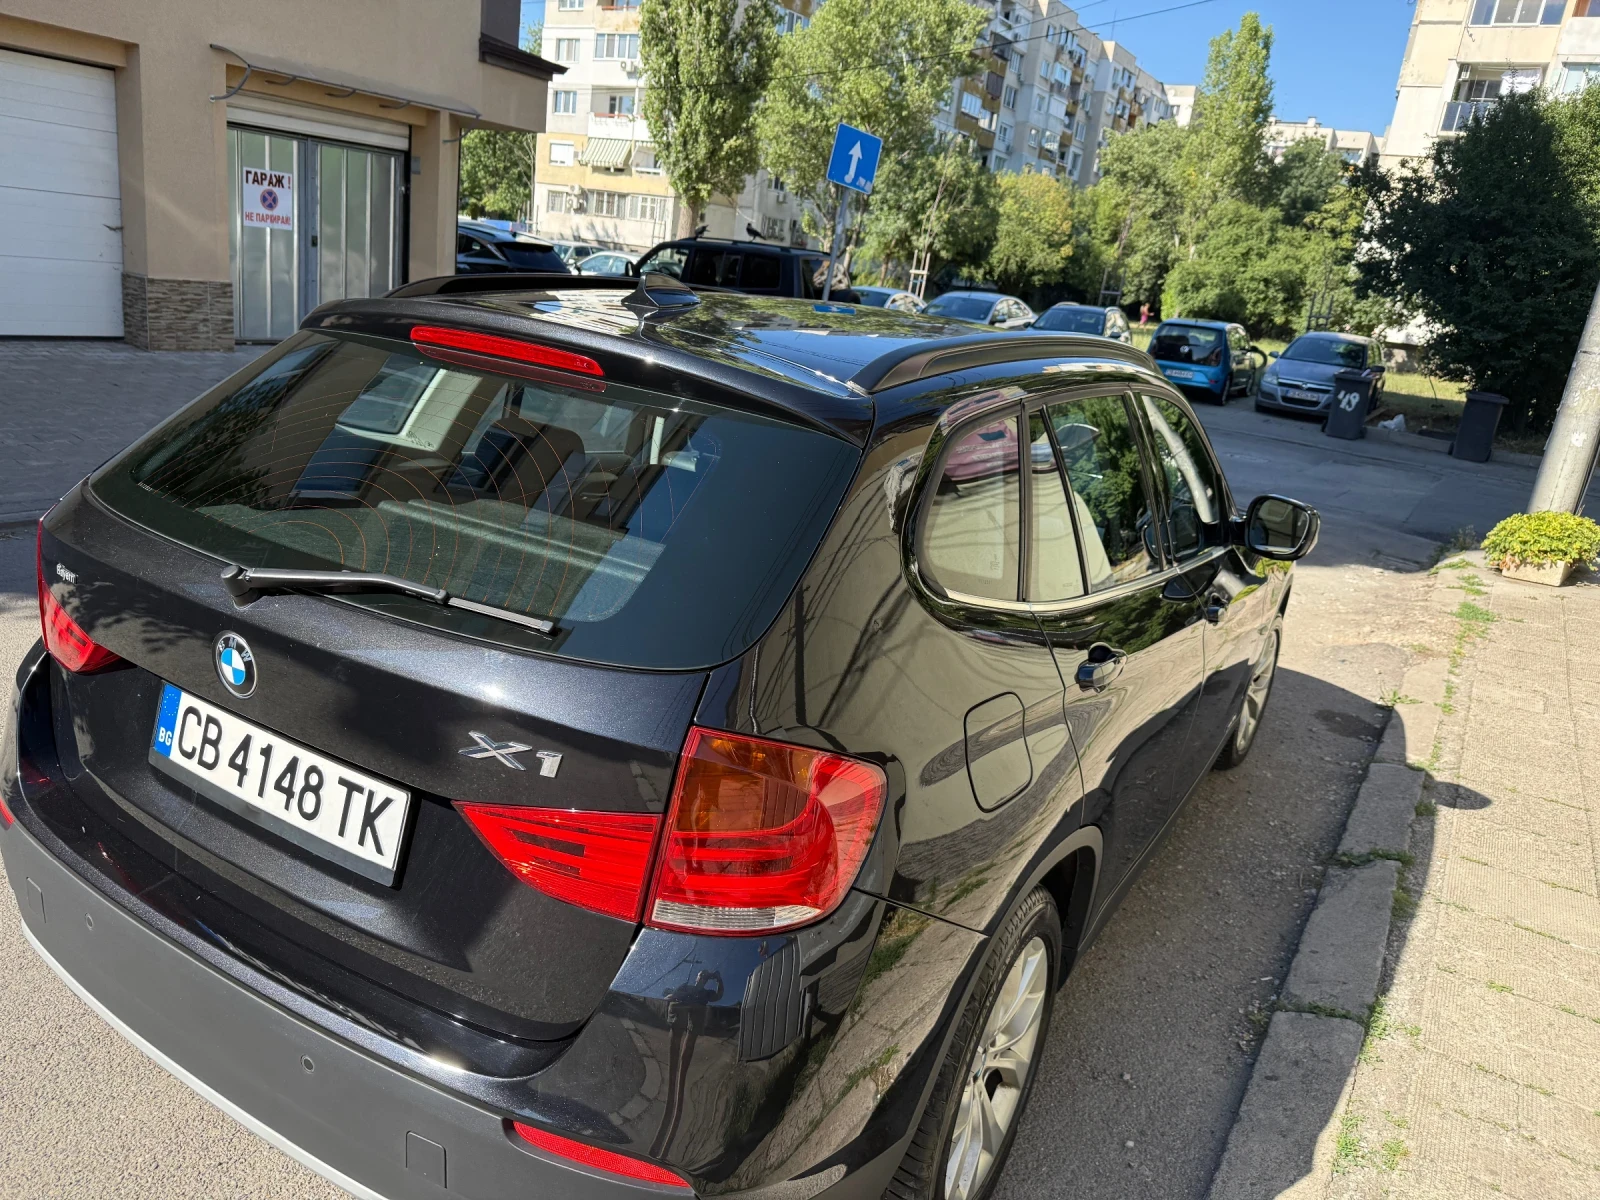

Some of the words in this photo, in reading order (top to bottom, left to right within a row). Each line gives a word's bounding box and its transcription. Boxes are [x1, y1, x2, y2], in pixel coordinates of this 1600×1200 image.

[245, 170, 284, 189] ГАРАЖ
[245, 211, 254, 222] НЕ
[218, 636, 252, 662] BMW
[158, 726, 173, 746] BG
[228, 734, 324, 821] 4148
[337, 775, 393, 856] TK
